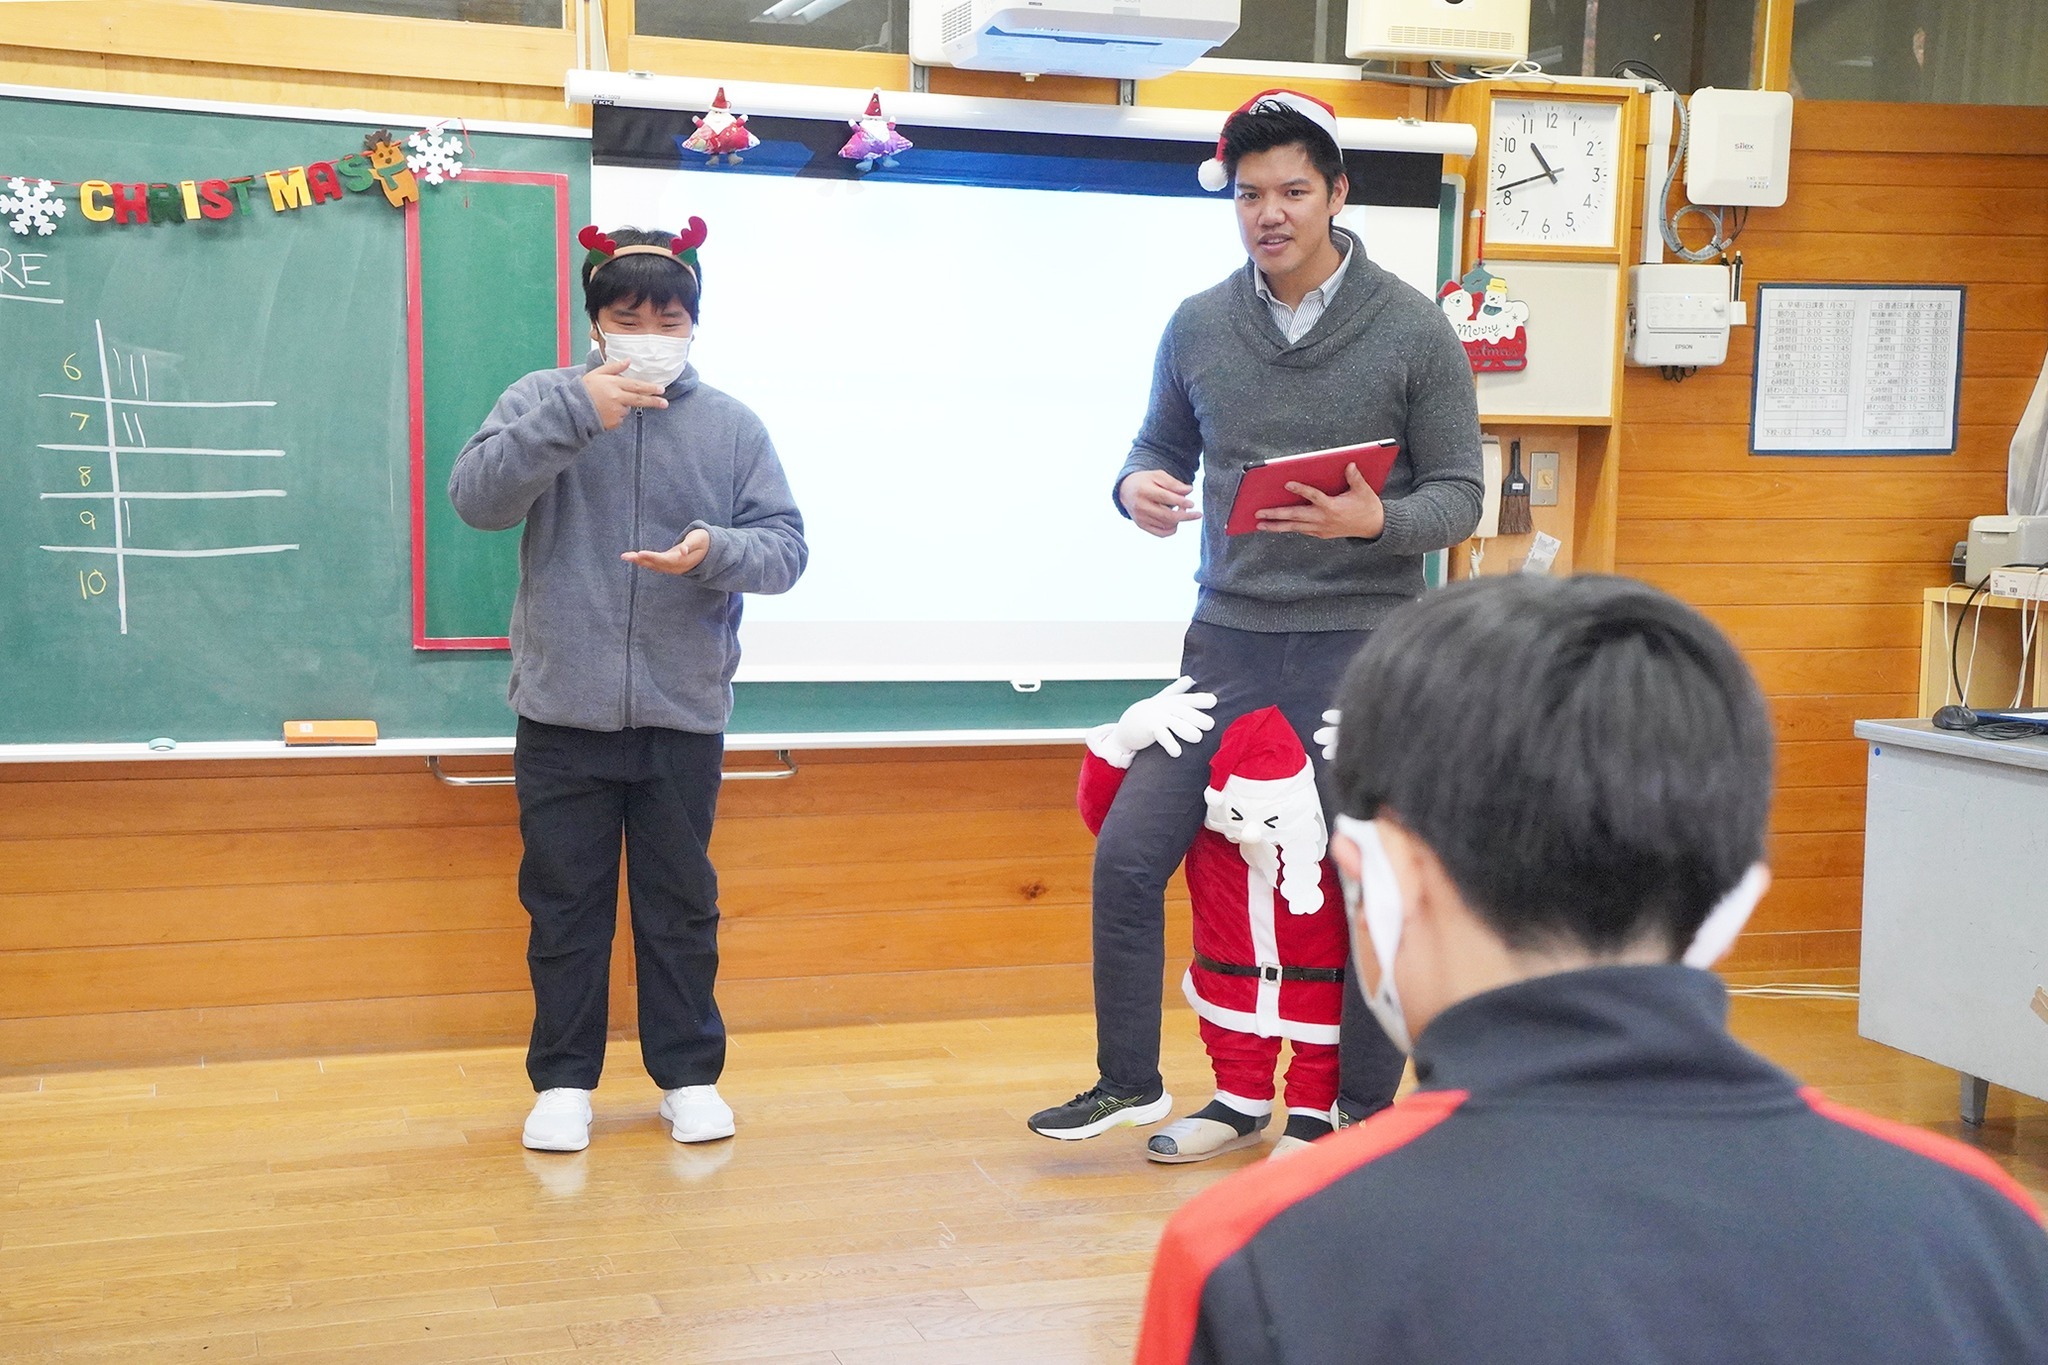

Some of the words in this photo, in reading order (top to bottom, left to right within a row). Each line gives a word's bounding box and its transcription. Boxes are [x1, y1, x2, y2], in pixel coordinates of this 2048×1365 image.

[1523, 119, 1533, 134] 11
[1546, 113, 1558, 129] 12
[1504, 137, 1516, 153] 10
[1586, 141, 1594, 156] 2
[1734, 142, 1754, 150] silex
[1497, 163, 1506, 179] 9
[1592, 167, 1600, 182] 3
[1503, 190, 1512, 206] 8
[1582, 193, 1591, 208] 4
[1521, 210, 1529, 226] 7
[1541, 218, 1550, 234] 6
[1565, 211, 1574, 227] 5
[63, 352, 82, 380] 6
[69, 412, 90, 431] 7
[78, 465, 92, 487] 8
[79, 510, 96, 530] 9
[79, 568, 107, 600] 10
